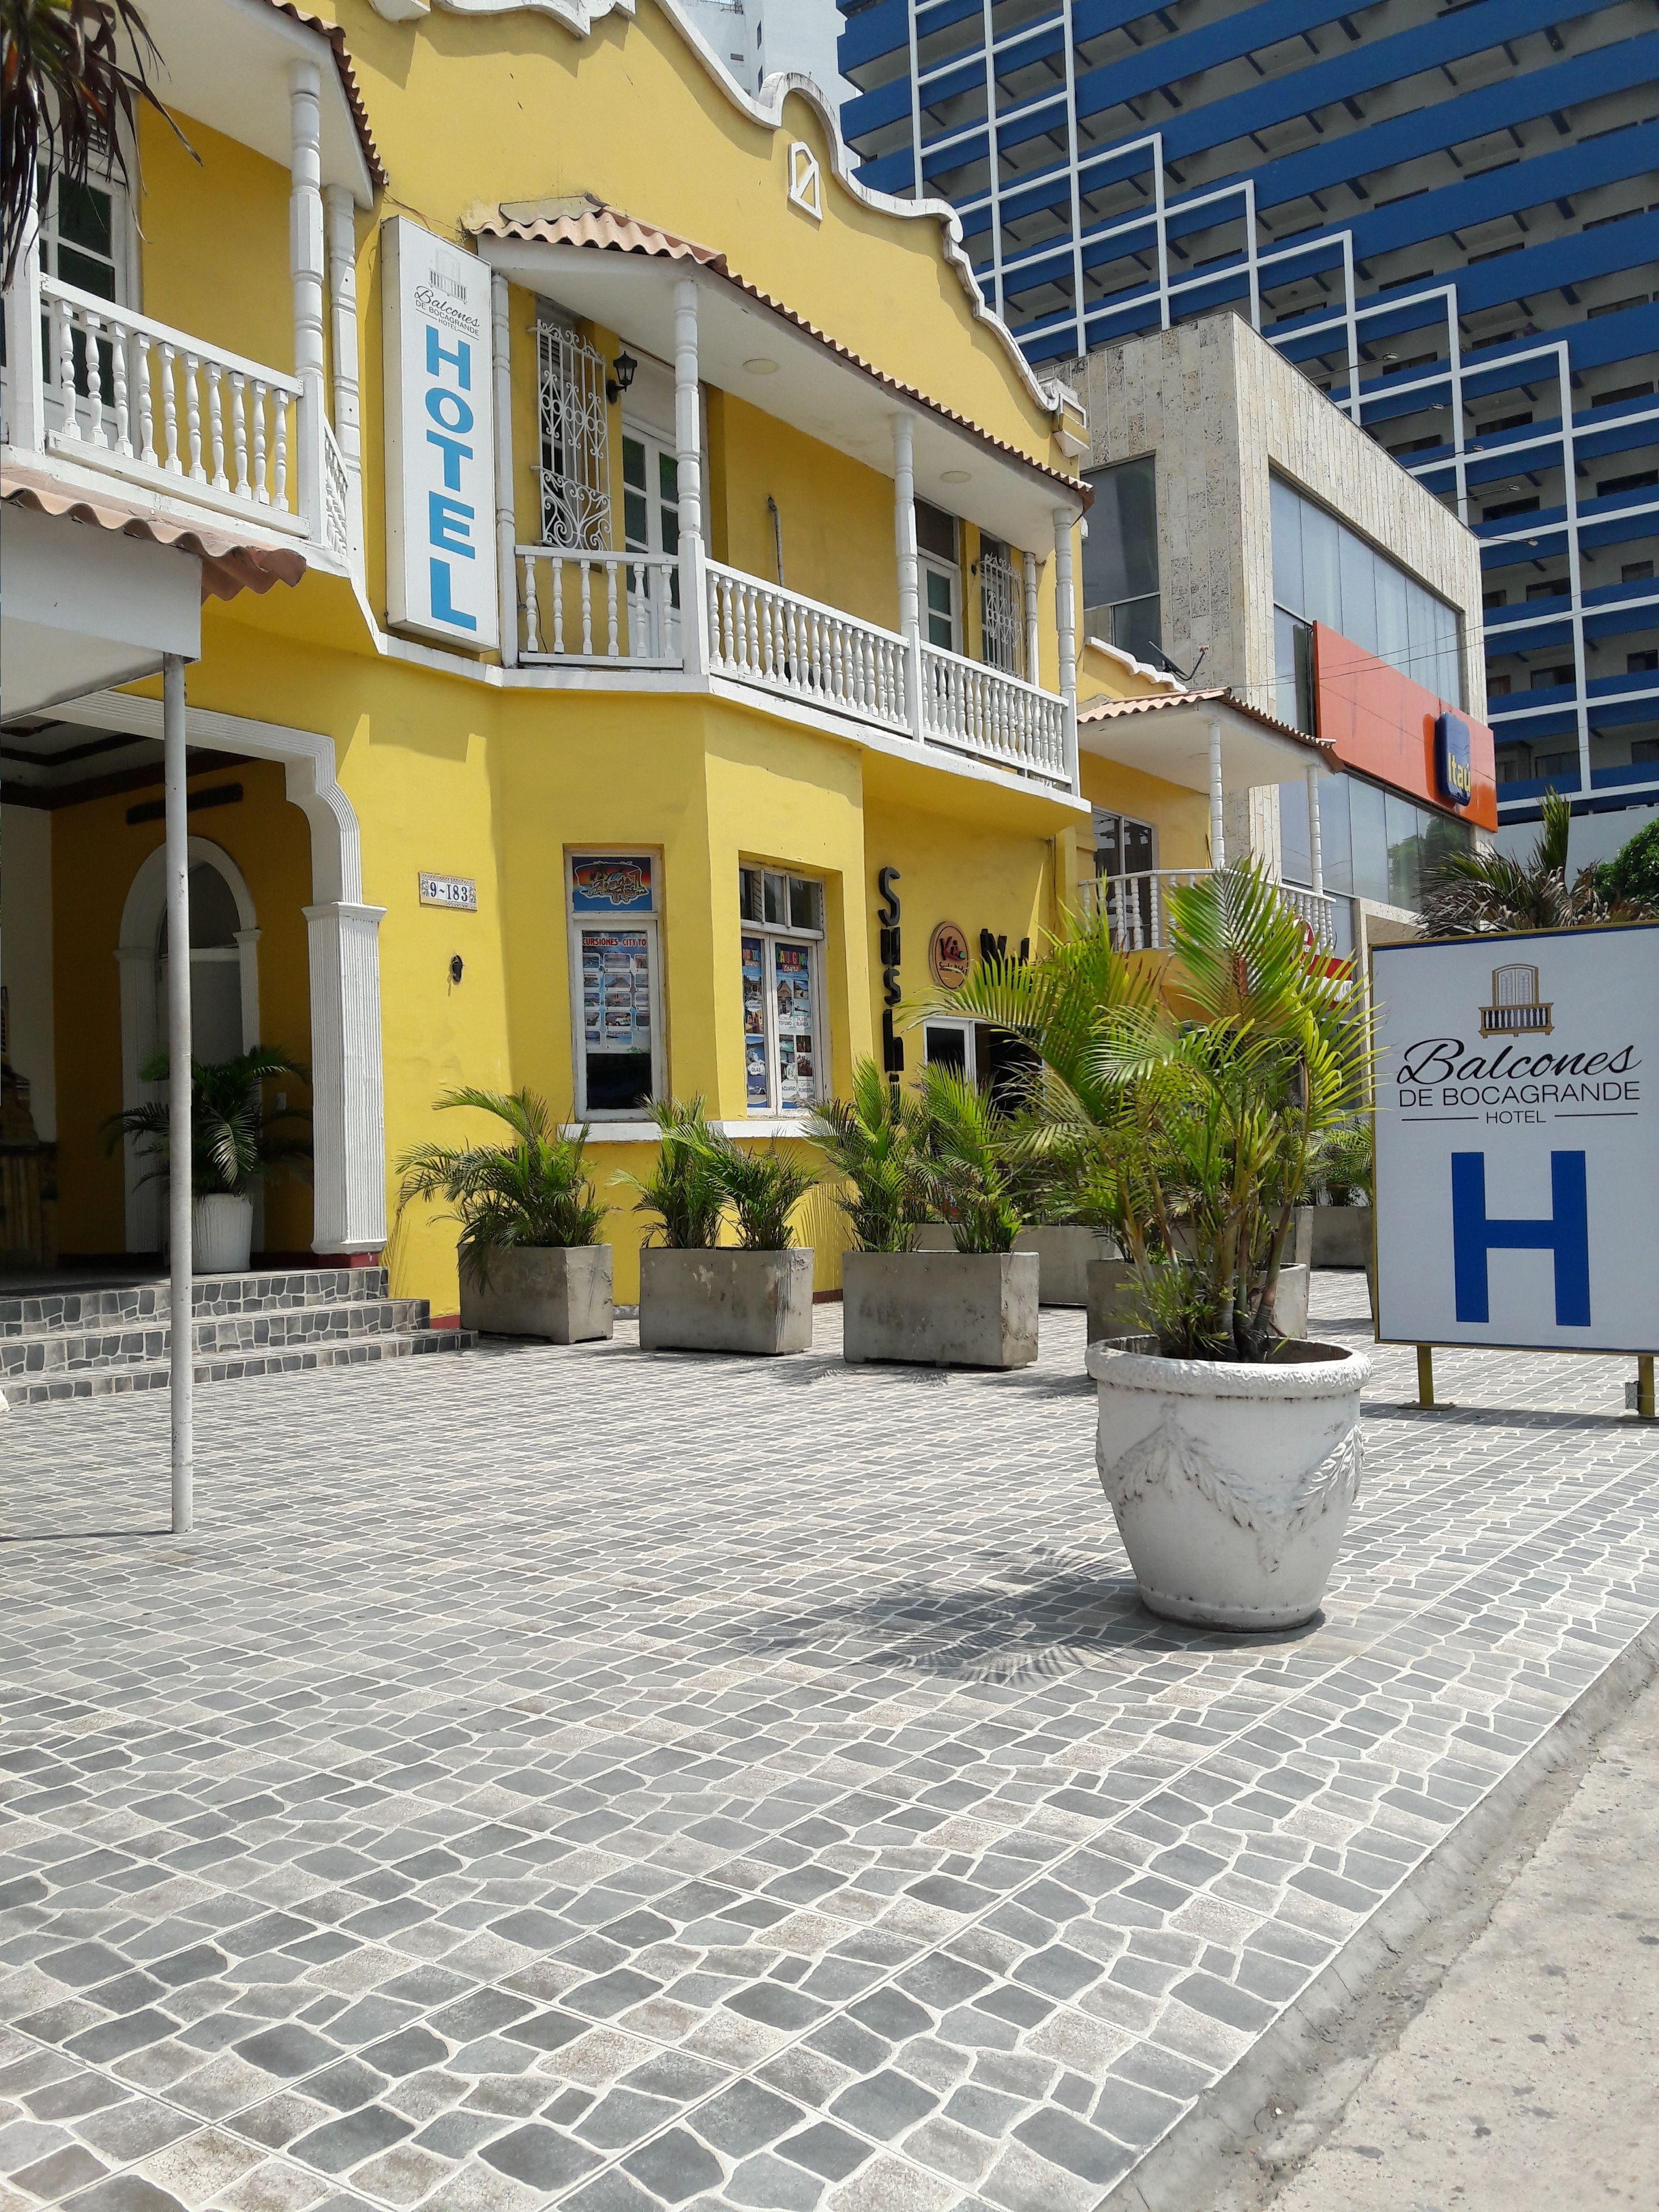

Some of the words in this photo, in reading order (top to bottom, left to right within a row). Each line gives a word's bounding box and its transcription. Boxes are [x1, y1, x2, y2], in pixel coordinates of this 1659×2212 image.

[415, 286, 480, 327] Balcones
[416, 300, 426, 310] DE
[429, 306, 479, 336] BOCAGRANDE
[438, 317, 458, 331] HOTEL
[425, 324, 477, 631] HOTEL
[1448, 752, 1471, 793] Itaú
[1397, 1038, 1642, 1085] Balcones
[1399, 1089, 1433, 1108] DE
[1443, 1081, 1641, 1107] BOCAGRANDE
[1486, 1111, 1547, 1124] HOTEL
[1451, 1150, 1591, 1327] H
